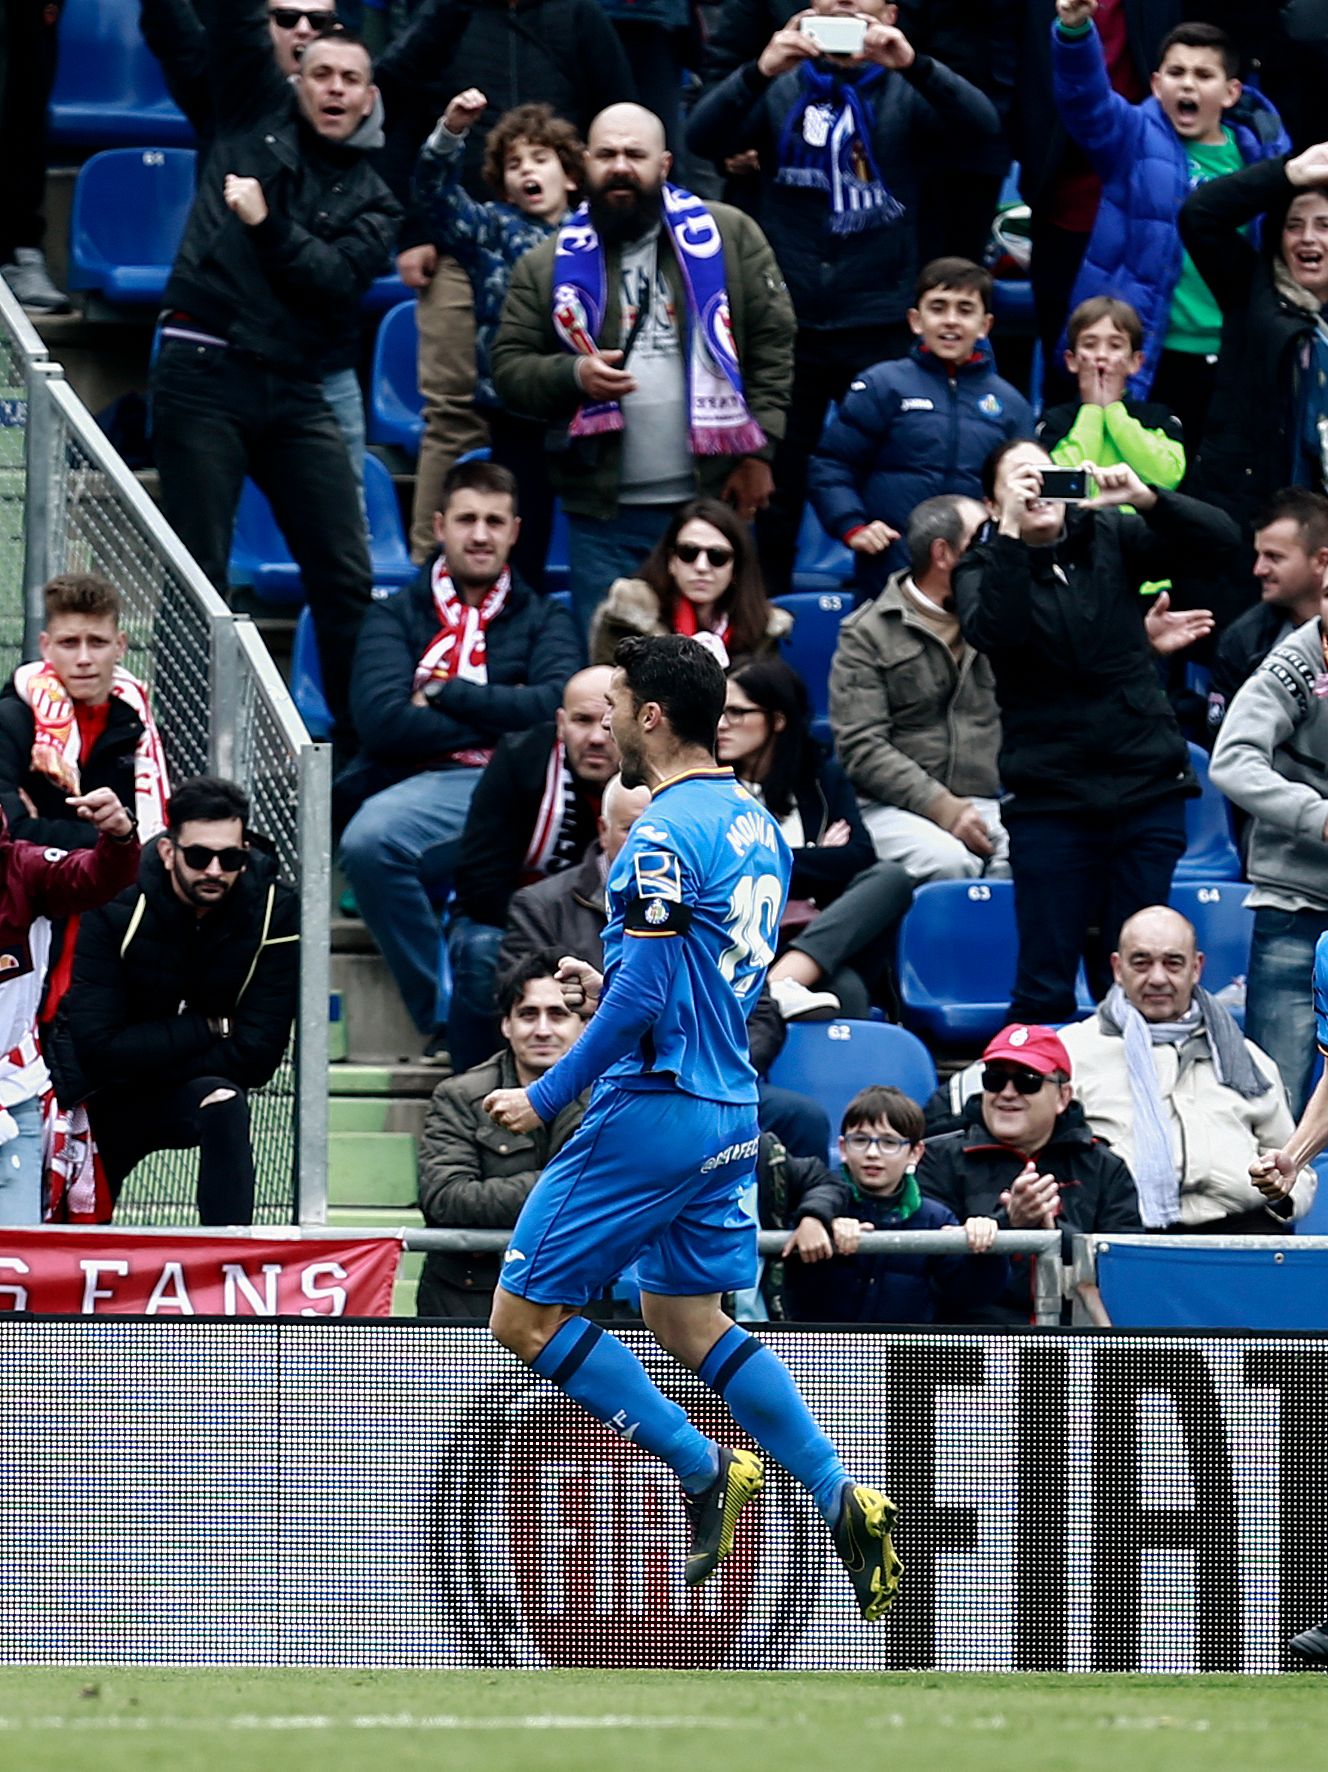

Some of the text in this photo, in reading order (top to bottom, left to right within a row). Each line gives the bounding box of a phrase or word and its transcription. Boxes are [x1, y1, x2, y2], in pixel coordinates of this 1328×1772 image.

[818, 595, 842, 611] 63
[967, 884, 991, 901] 63
[1197, 886, 1220, 904] 64
[827, 1024, 851, 1040] 62
[79, 1260, 348, 1317] FANS
